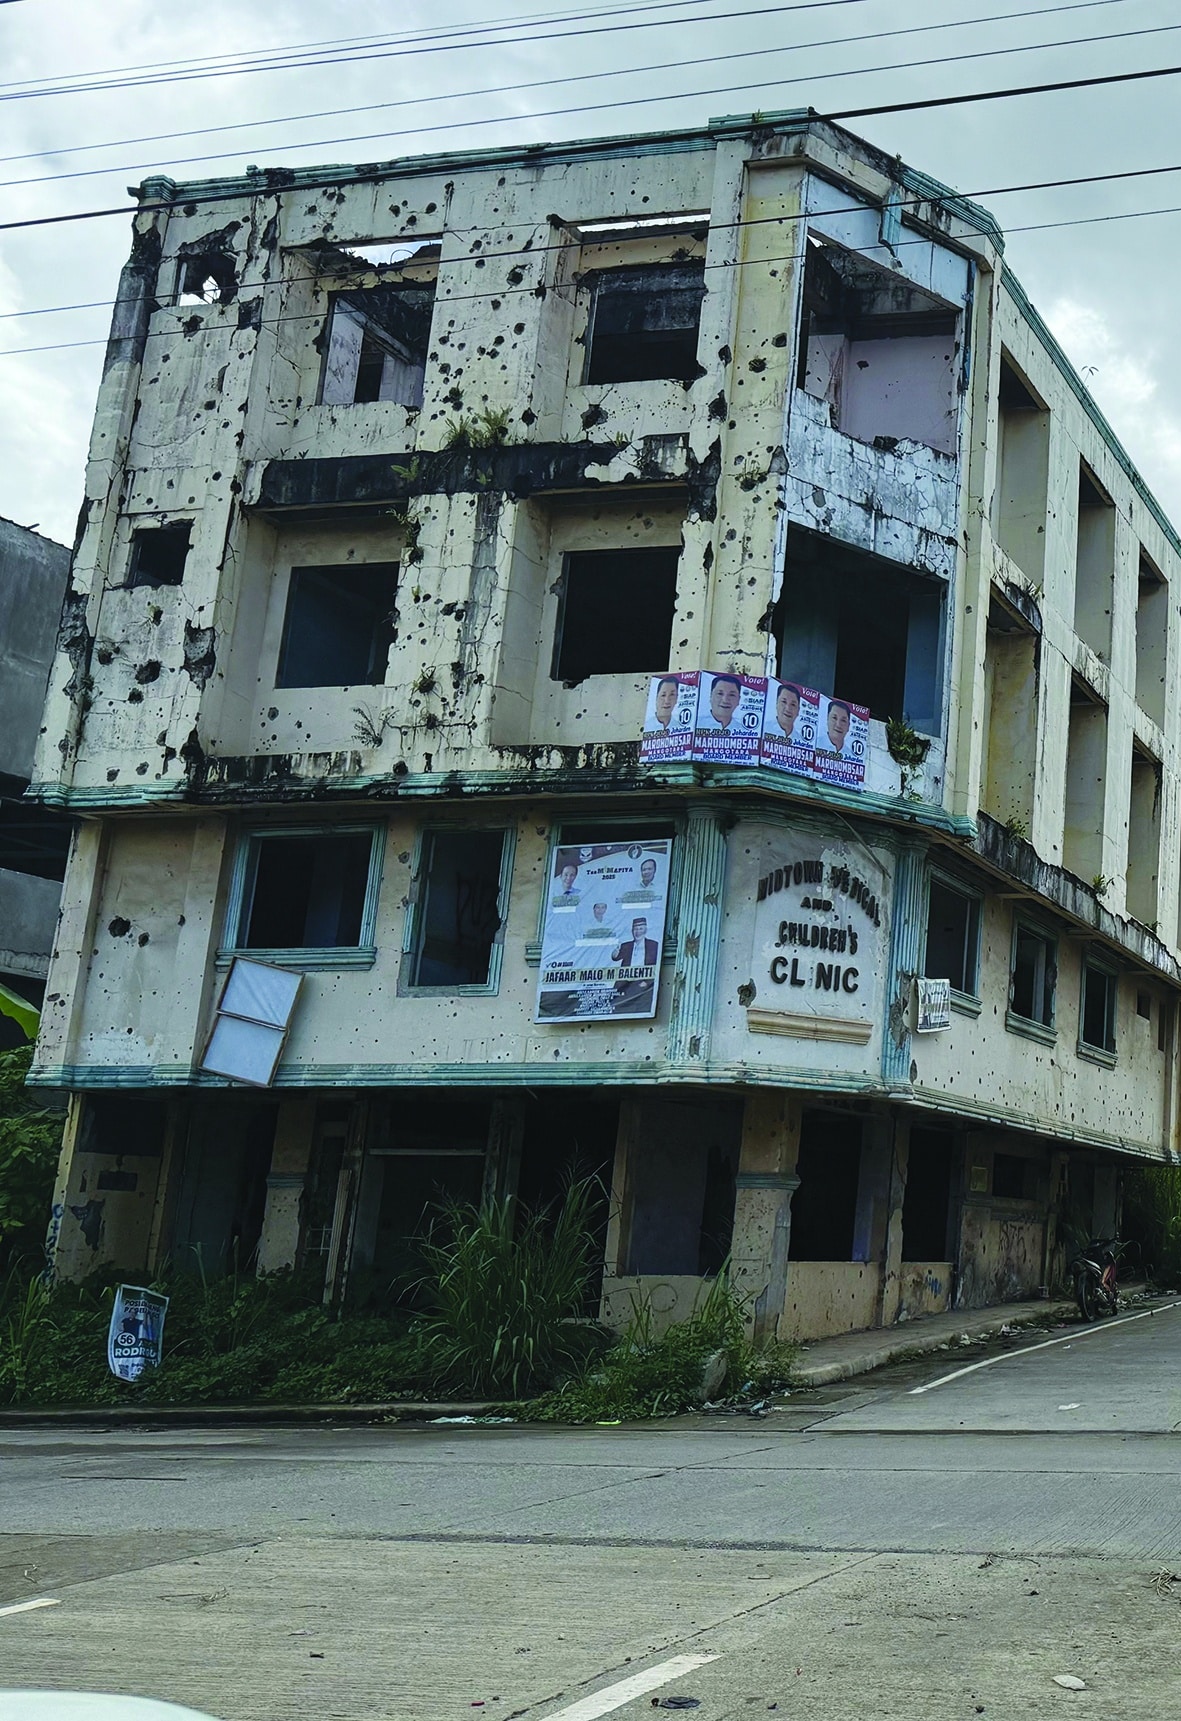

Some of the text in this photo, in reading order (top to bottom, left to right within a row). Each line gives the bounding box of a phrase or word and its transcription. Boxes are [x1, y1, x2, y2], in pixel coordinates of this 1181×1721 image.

[744, 676, 765, 685] Vote!
[802, 687, 819, 699] Vote!
[852, 704, 869, 715] Vote!
[680, 710, 690, 723] 10
[745, 715, 757, 727] 10
[802, 727, 813, 740] 10
[853, 742, 863, 754] 10
[800, 897, 832, 912] AND
[779, 920, 858, 955] CHILDREN'S
[545, 971, 576, 982] JAFAAR
[580, 970, 603, 981] MALO
[607, 969, 615, 979] M
[770, 956, 859, 993] CLNIC
[120, 1335, 133, 1344] 56
